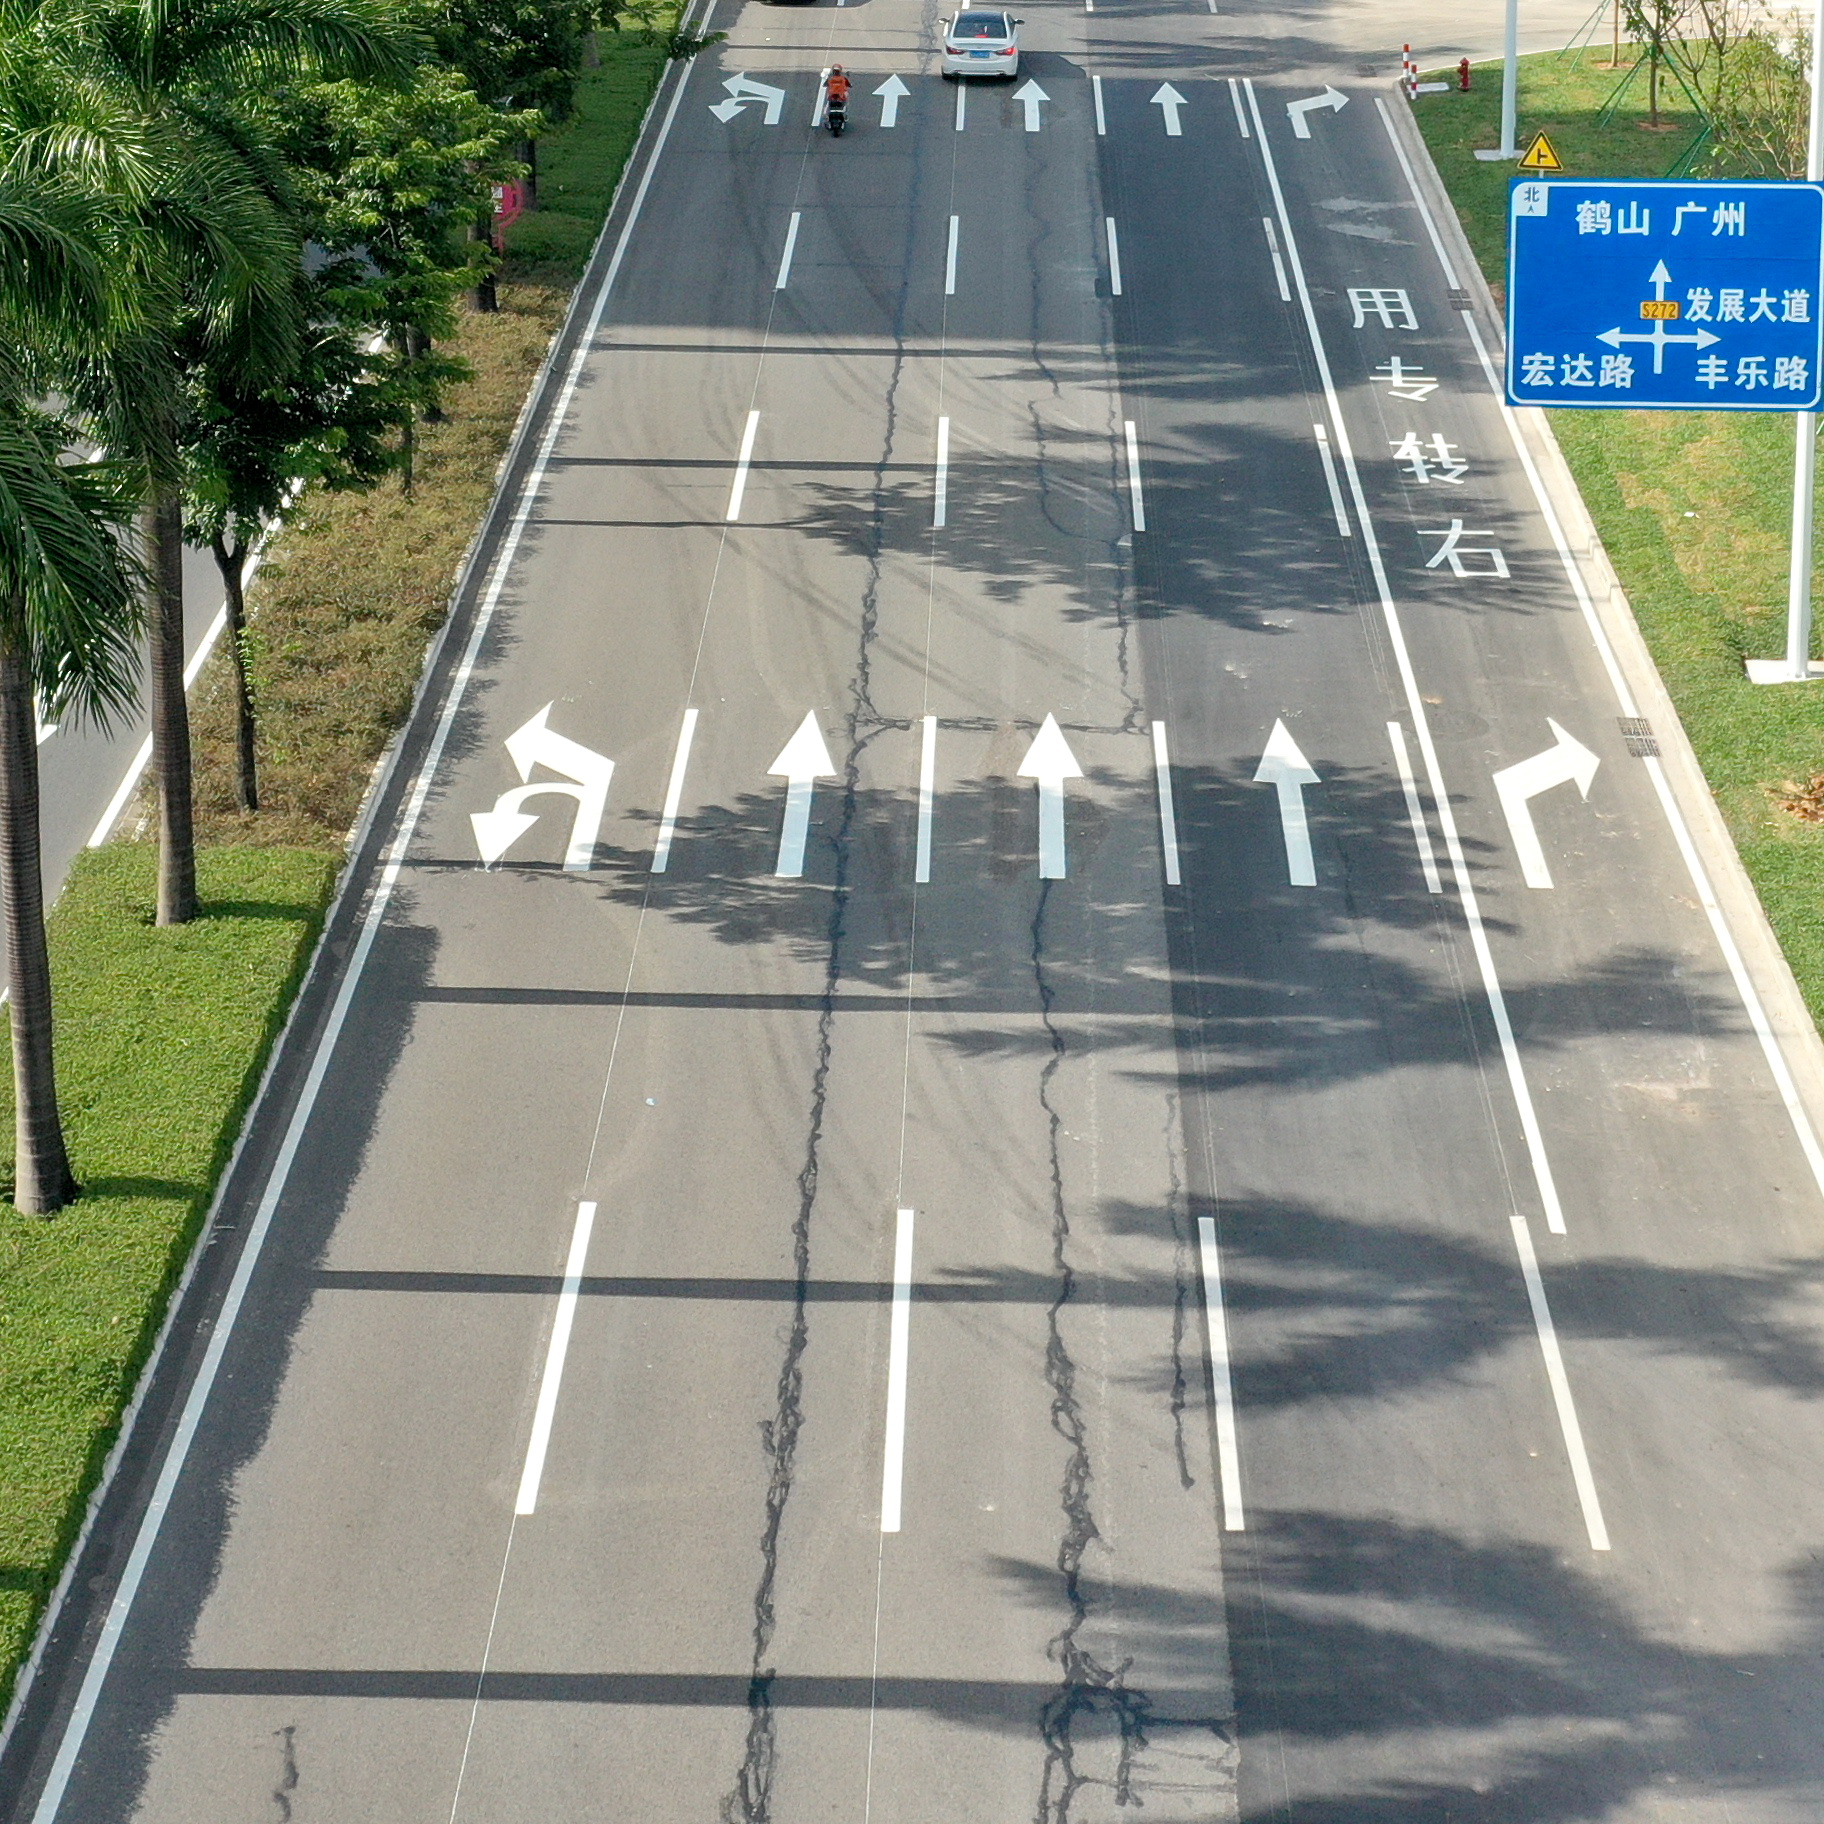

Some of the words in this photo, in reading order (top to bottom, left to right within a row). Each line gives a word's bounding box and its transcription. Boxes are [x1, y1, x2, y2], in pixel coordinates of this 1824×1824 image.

[1524, 187, 1539, 204] 北
[1575, 201, 1650, 236] 鹤山
[1671, 201, 1746, 237] 广州
[1642, 302, 1677, 320] S272
[1684, 288, 1811, 323] 发展大道
[1521, 352, 1635, 389] 宏达路
[1695, 356, 1809, 390] 丰乐路
